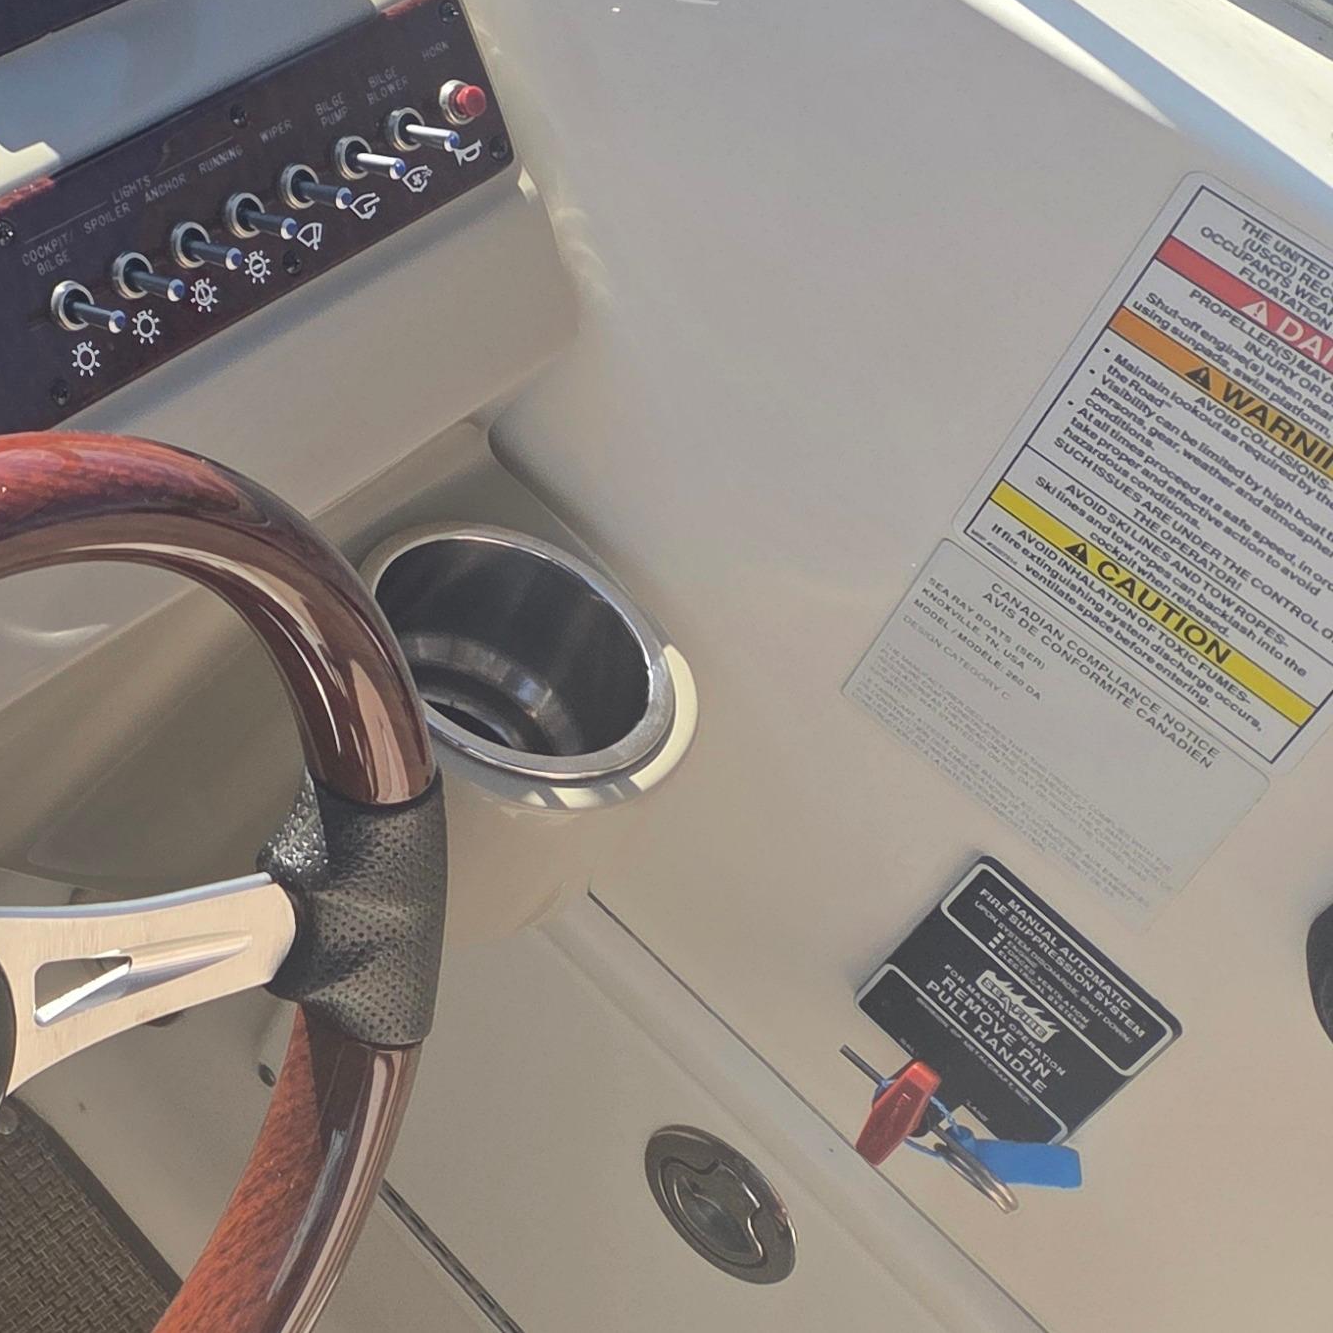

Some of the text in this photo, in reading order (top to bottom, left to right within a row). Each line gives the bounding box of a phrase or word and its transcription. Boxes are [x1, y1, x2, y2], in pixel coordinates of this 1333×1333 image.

[315, 91, 344, 115] BILGE
[320, 106, 349, 128] PUMP
[366, 76, 409, 106] BLOWER
[368, 66, 398, 89] BILGE
[260, 119, 293, 143] WIPER
[83, 202, 131, 235] SPOILER
[144, 173, 187, 203] ANCHOR
[198, 144, 244, 175] RUNNING
[111, 175, 151, 204] LIGHTS
[1275, 316, 1333, 365] DA
[1065, 485, 1107, 515] AVOID
[1107, 513, 1131, 533] SKI
[1130, 529, 1171, 562] LINES
[1170, 560, 1202, 584] AND
[1203, 581, 1235, 607] TOW
[1098, 561, 1230, 663] CAUTION
[982, 593, 1016, 619] AVIS
[1018, 617, 1038, 636] DE
[1136, 708, 1212, 768] CANADIEN
[991, 583, 1219, 758] CANADIAN COMPLIANCE NOTICE
[980, 888, 1145, 1037] FIRE SUPPRESSION SYSTEM
[1008, 899, 1131, 1009] MANUAL AUTOMATIC
[926, 980, 967, 1023] PULL
[974, 1025, 1046, 1092] HANDLE
[942, 977, 1050, 1077] REMOVE PIN
